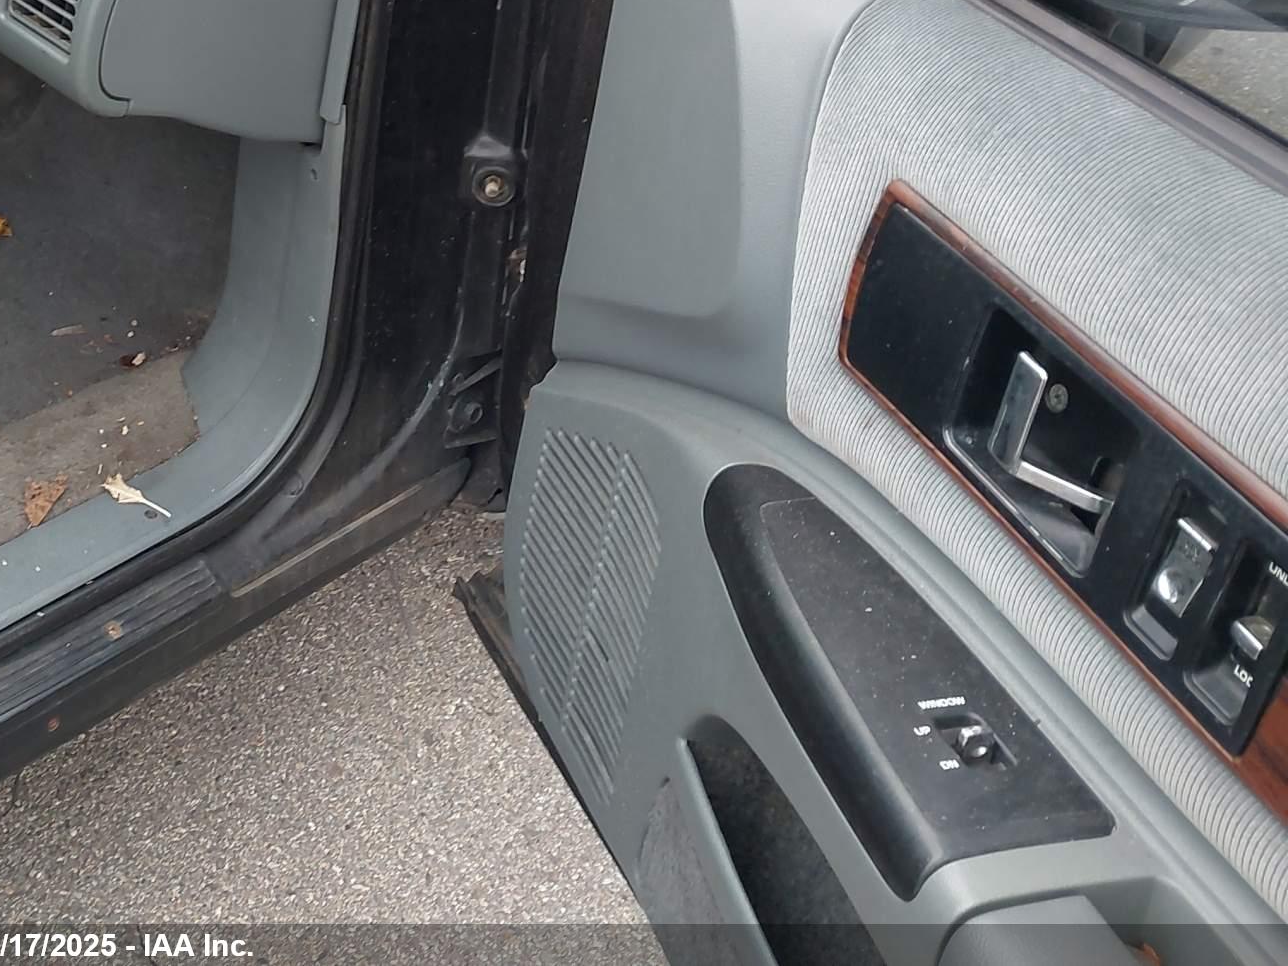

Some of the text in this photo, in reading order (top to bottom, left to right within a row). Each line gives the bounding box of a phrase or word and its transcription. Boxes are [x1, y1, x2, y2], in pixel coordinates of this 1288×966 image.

[917, 696, 966, 710] WINDOW
[913, 725, 932, 736] UP
[939, 759, 960, 771] DN
